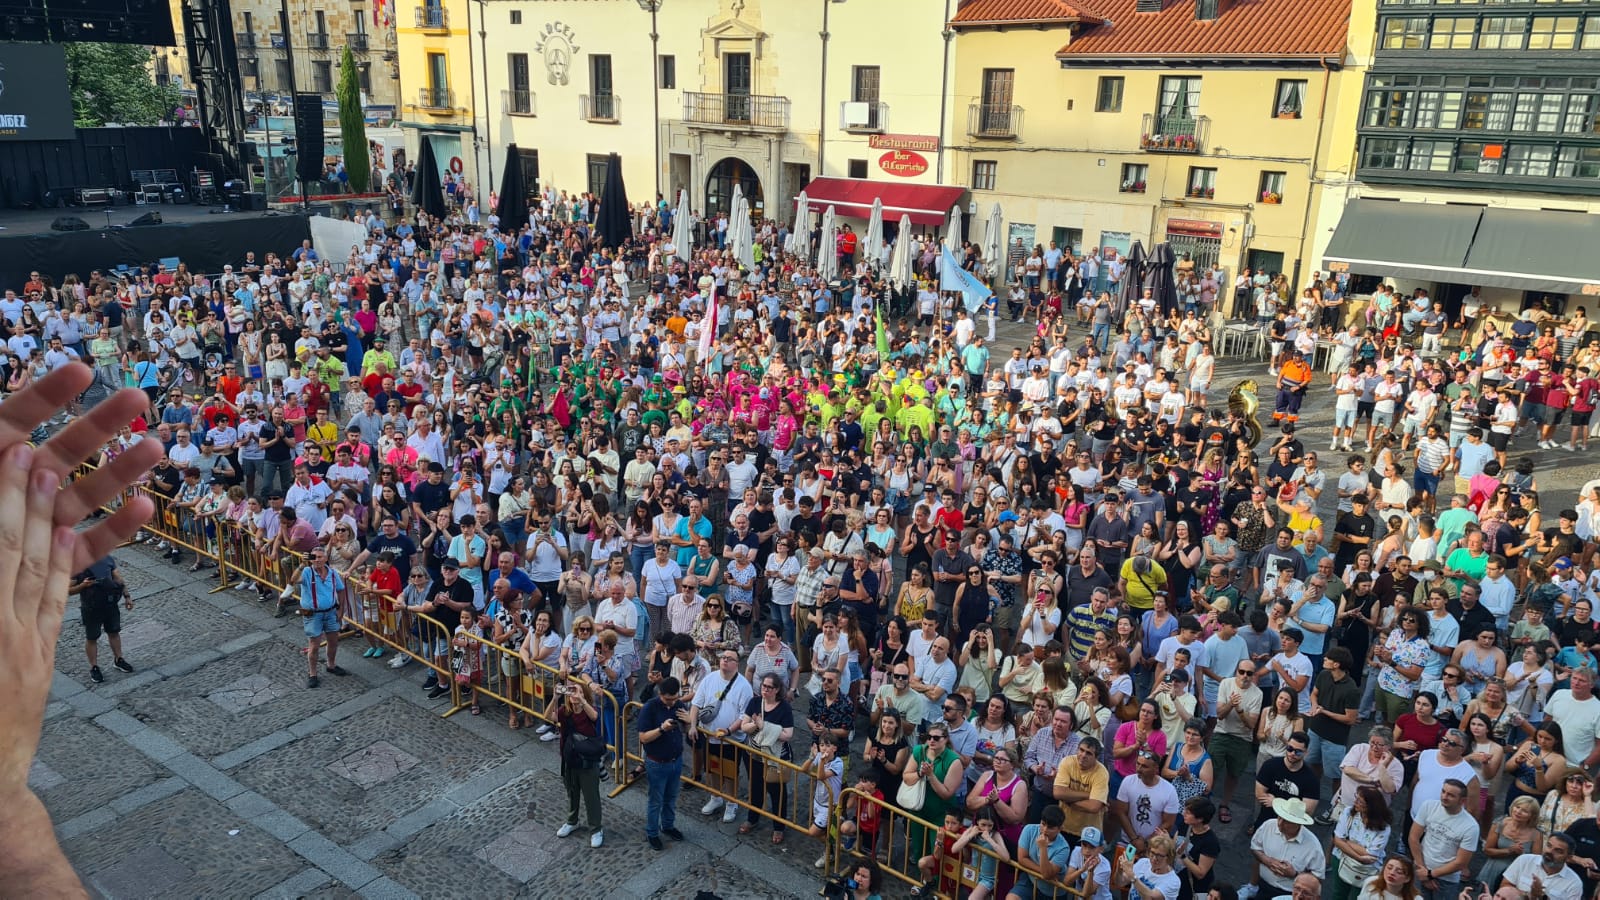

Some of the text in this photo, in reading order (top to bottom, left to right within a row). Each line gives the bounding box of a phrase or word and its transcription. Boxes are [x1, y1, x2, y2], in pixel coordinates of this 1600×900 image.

[0, 115, 27, 128] NDEZ
[871, 135, 936, 150] Restaurante
[894, 150, 911, 160] Bar
